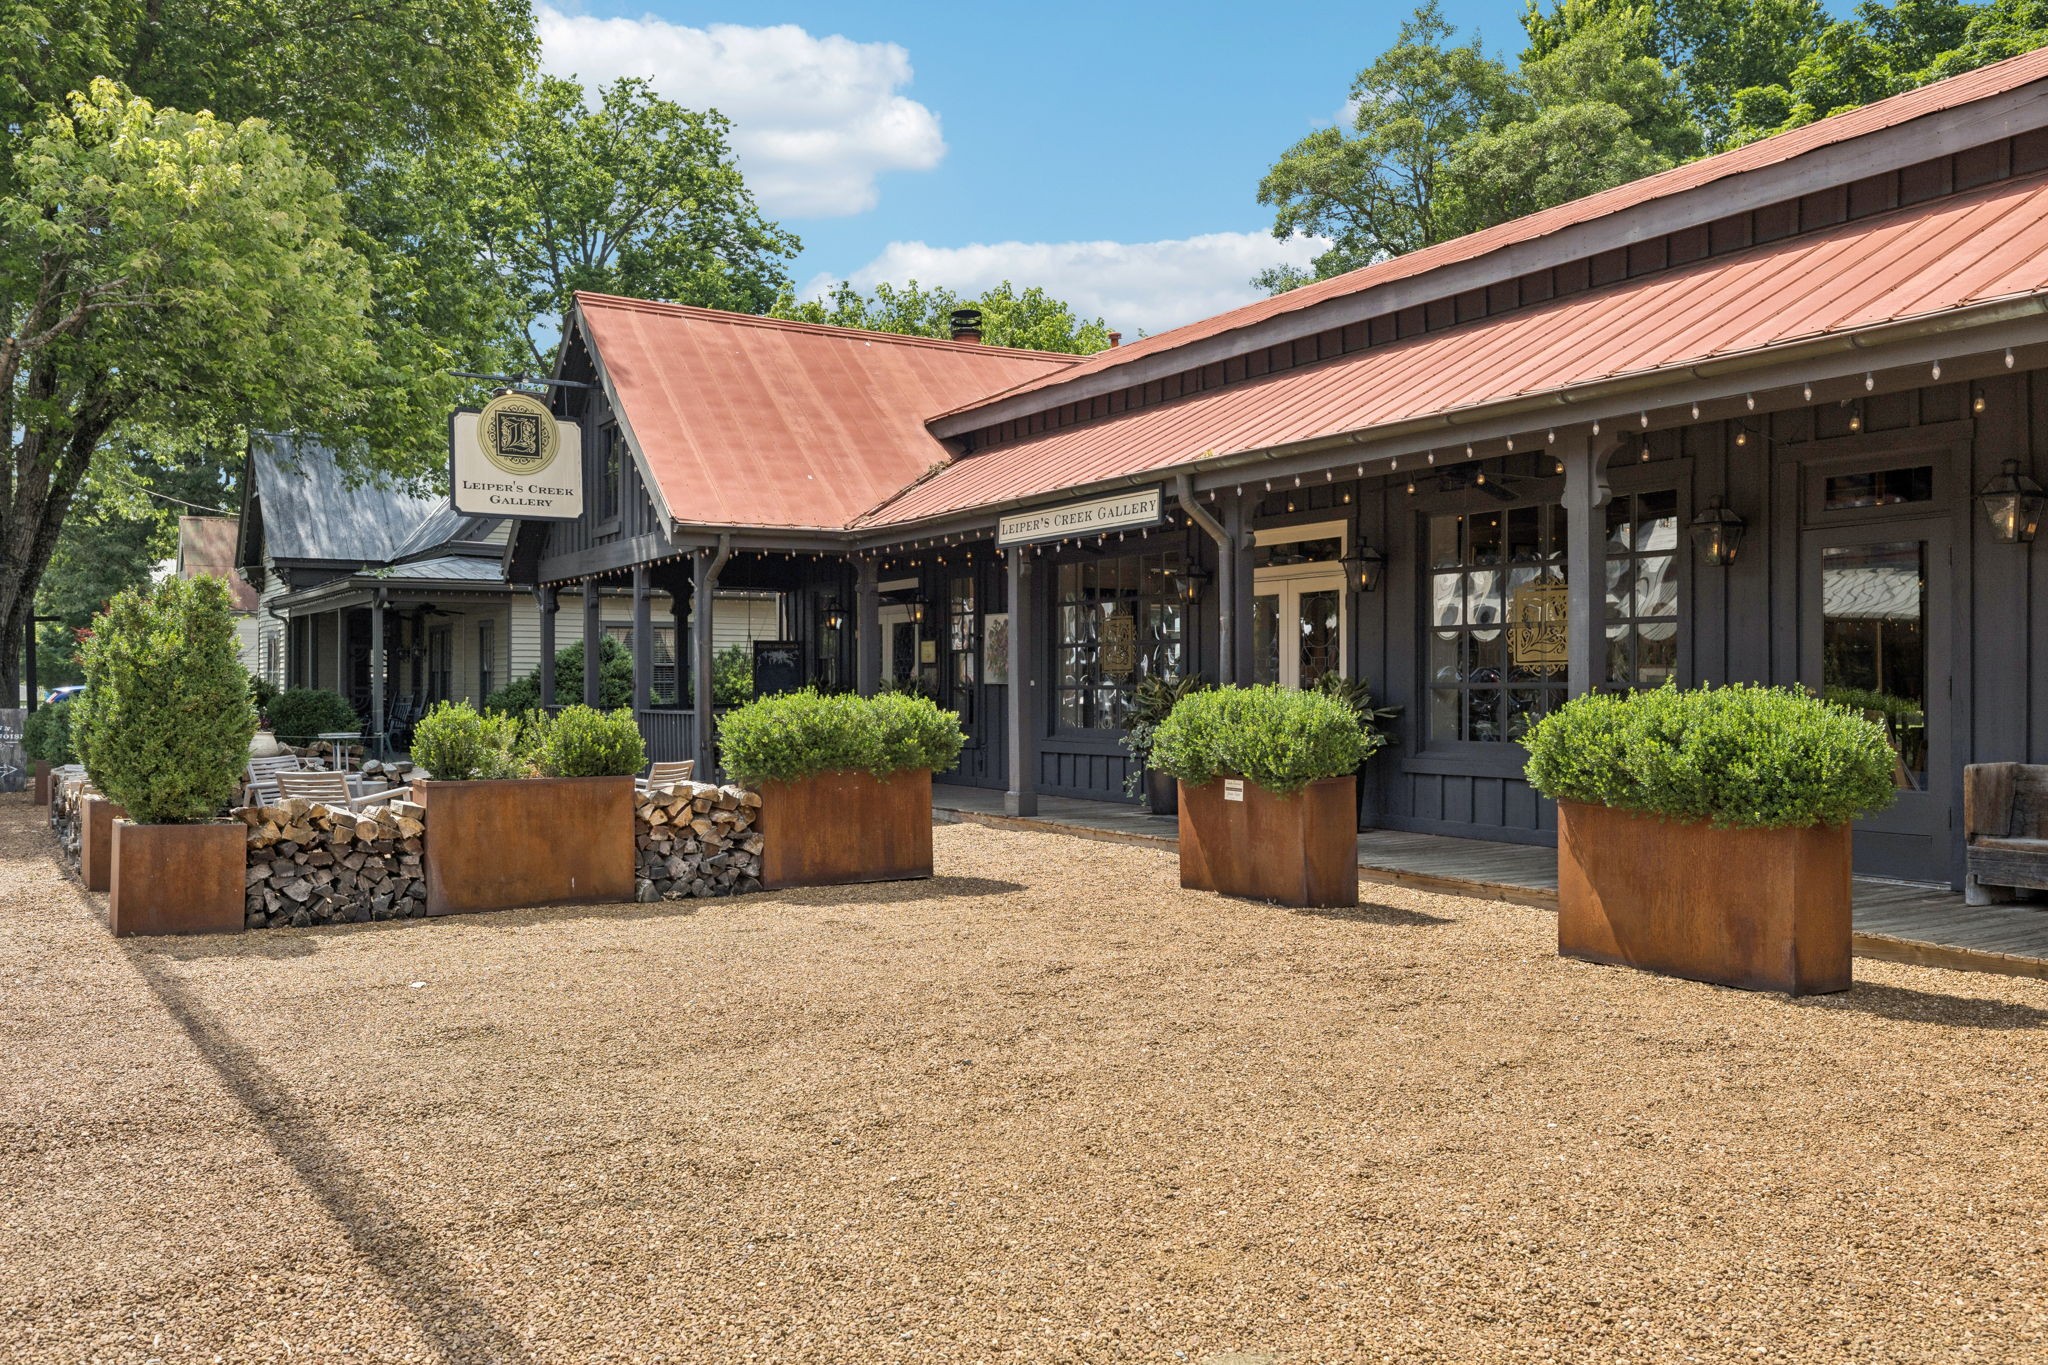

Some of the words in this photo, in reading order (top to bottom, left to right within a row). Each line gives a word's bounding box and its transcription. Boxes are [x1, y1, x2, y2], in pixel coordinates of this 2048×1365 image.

[463, 480, 524, 493] LEIPER'S
[528, 485, 574, 496] CREEK
[490, 495, 553, 507] GALLERY
[1002, 518, 1050, 535] LEIPER'S
[1054, 511, 1093, 526] CREEK
[1097, 499, 1157, 519] GALLERY
